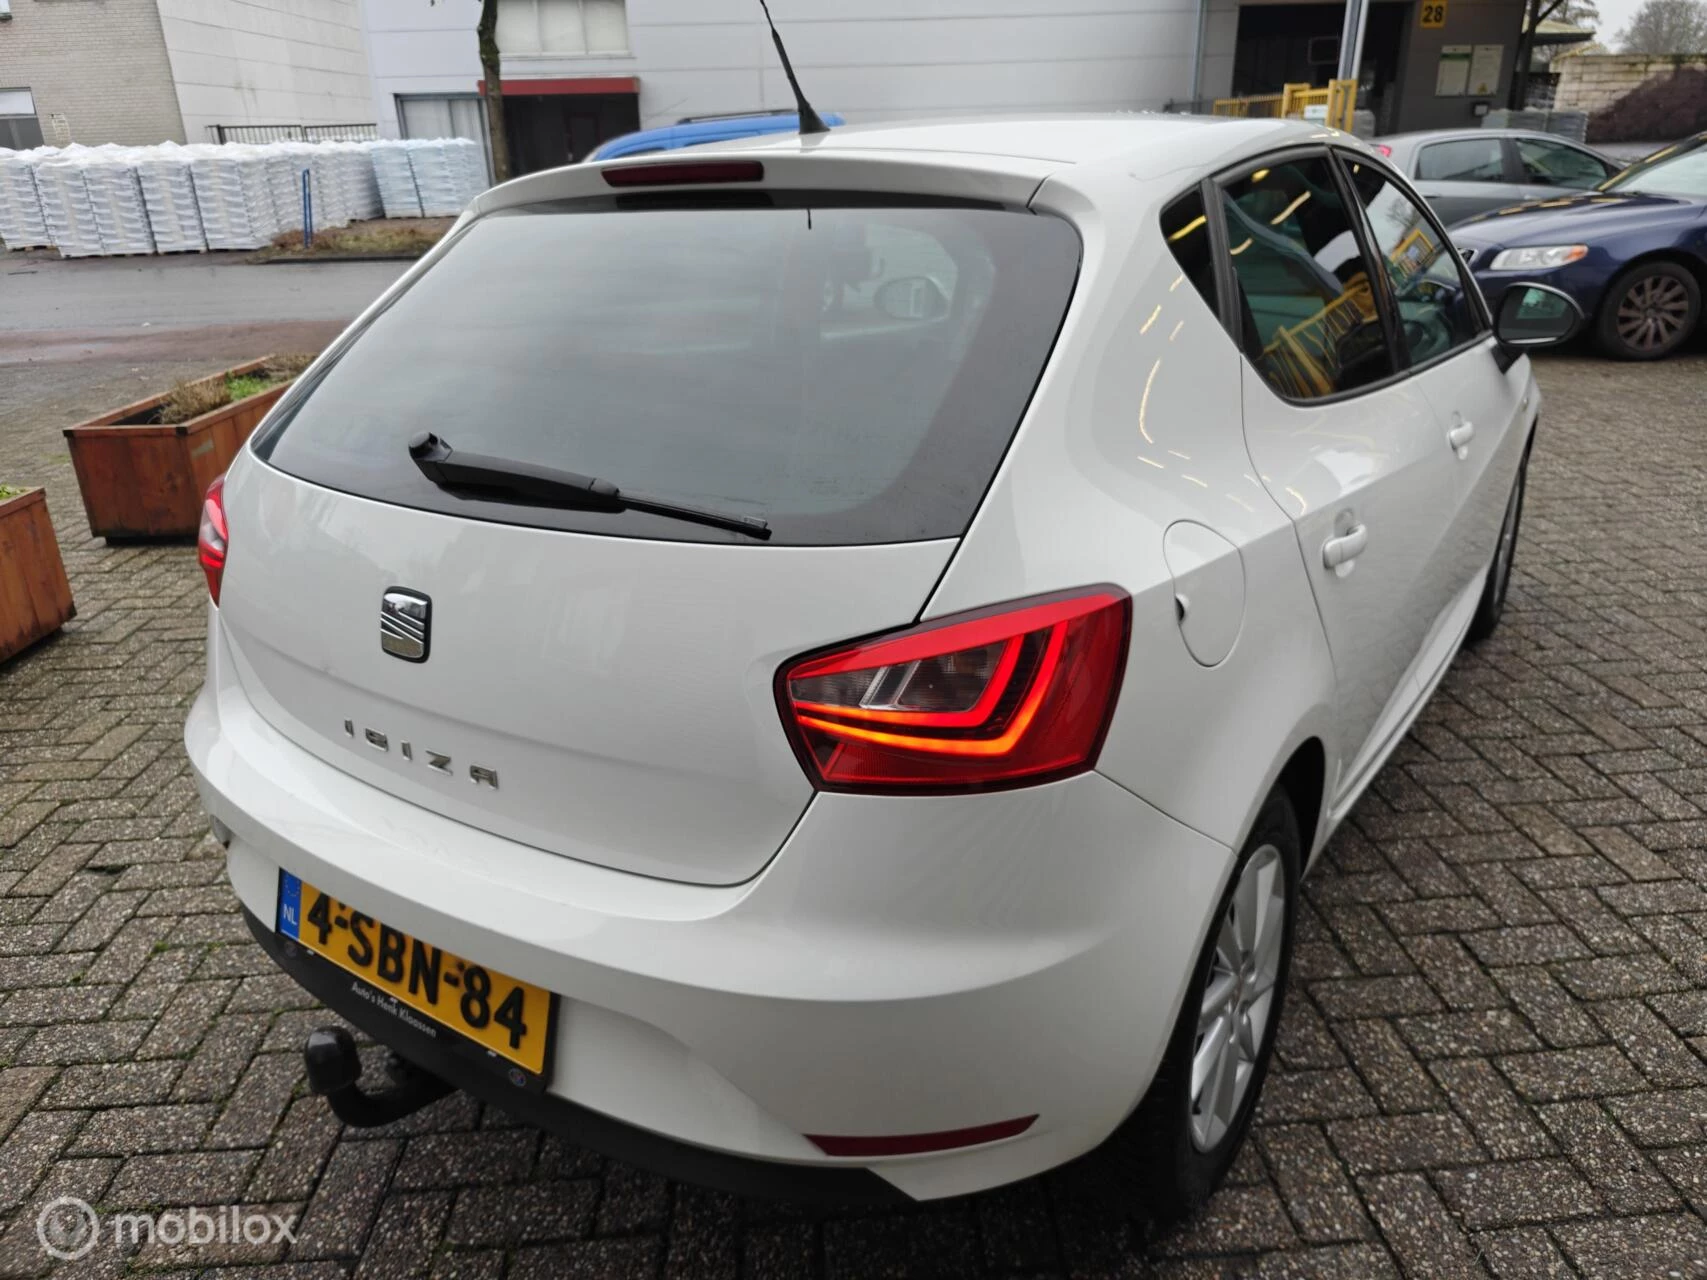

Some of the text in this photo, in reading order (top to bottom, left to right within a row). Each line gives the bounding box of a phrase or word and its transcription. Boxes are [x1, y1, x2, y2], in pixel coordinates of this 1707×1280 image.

[1422, 6, 1444, 23] 28
[344, 717, 499, 790] IBIZA
[283, 903, 298, 926] NL
[307, 892, 528, 1049] 4-SBN-84
